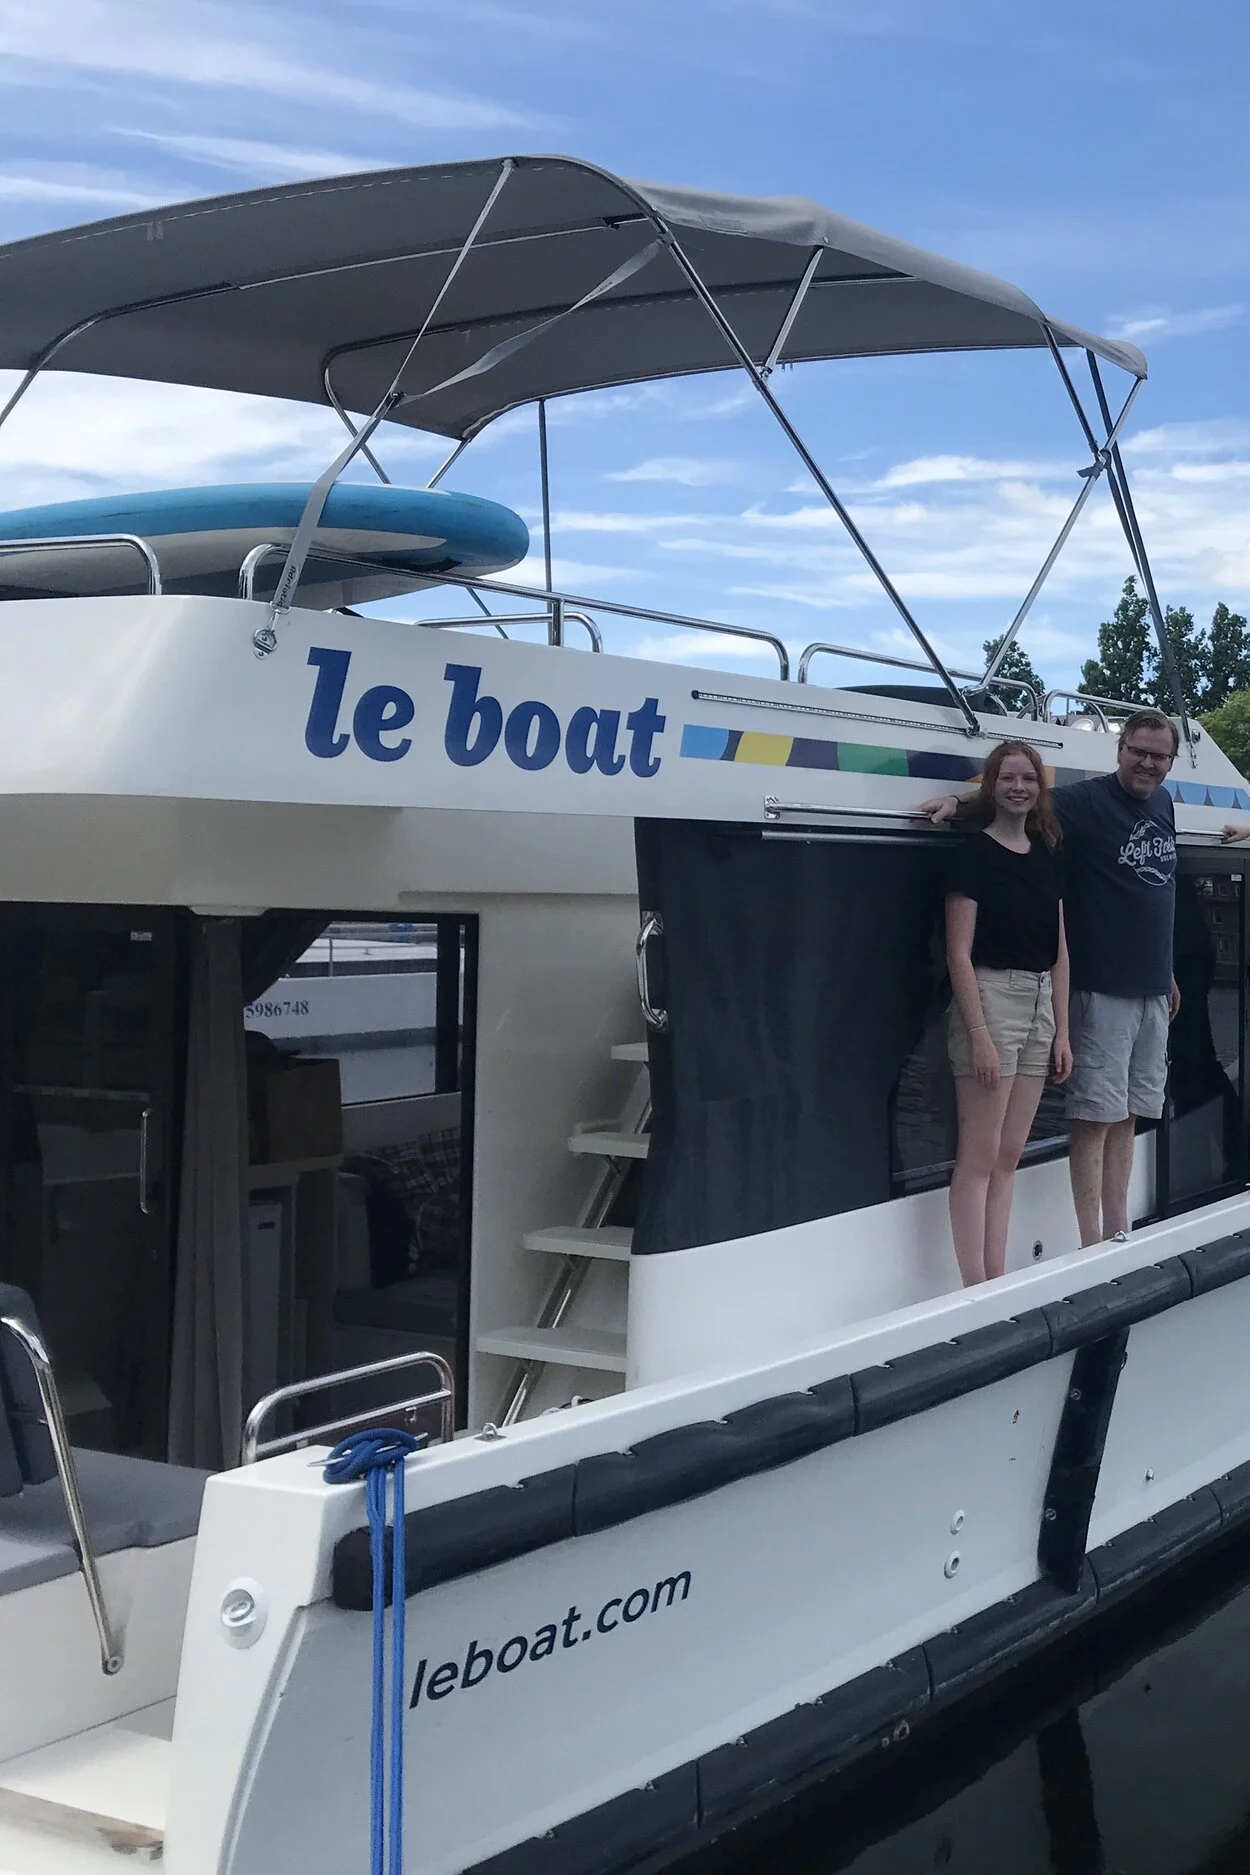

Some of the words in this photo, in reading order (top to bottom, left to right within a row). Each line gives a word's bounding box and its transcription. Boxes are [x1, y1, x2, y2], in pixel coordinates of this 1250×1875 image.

[305, 646, 415, 762] le
[443, 663, 666, 778] boat
[1117, 839, 1153, 867] Left
[408, 1570, 692, 1710] leboat.com
